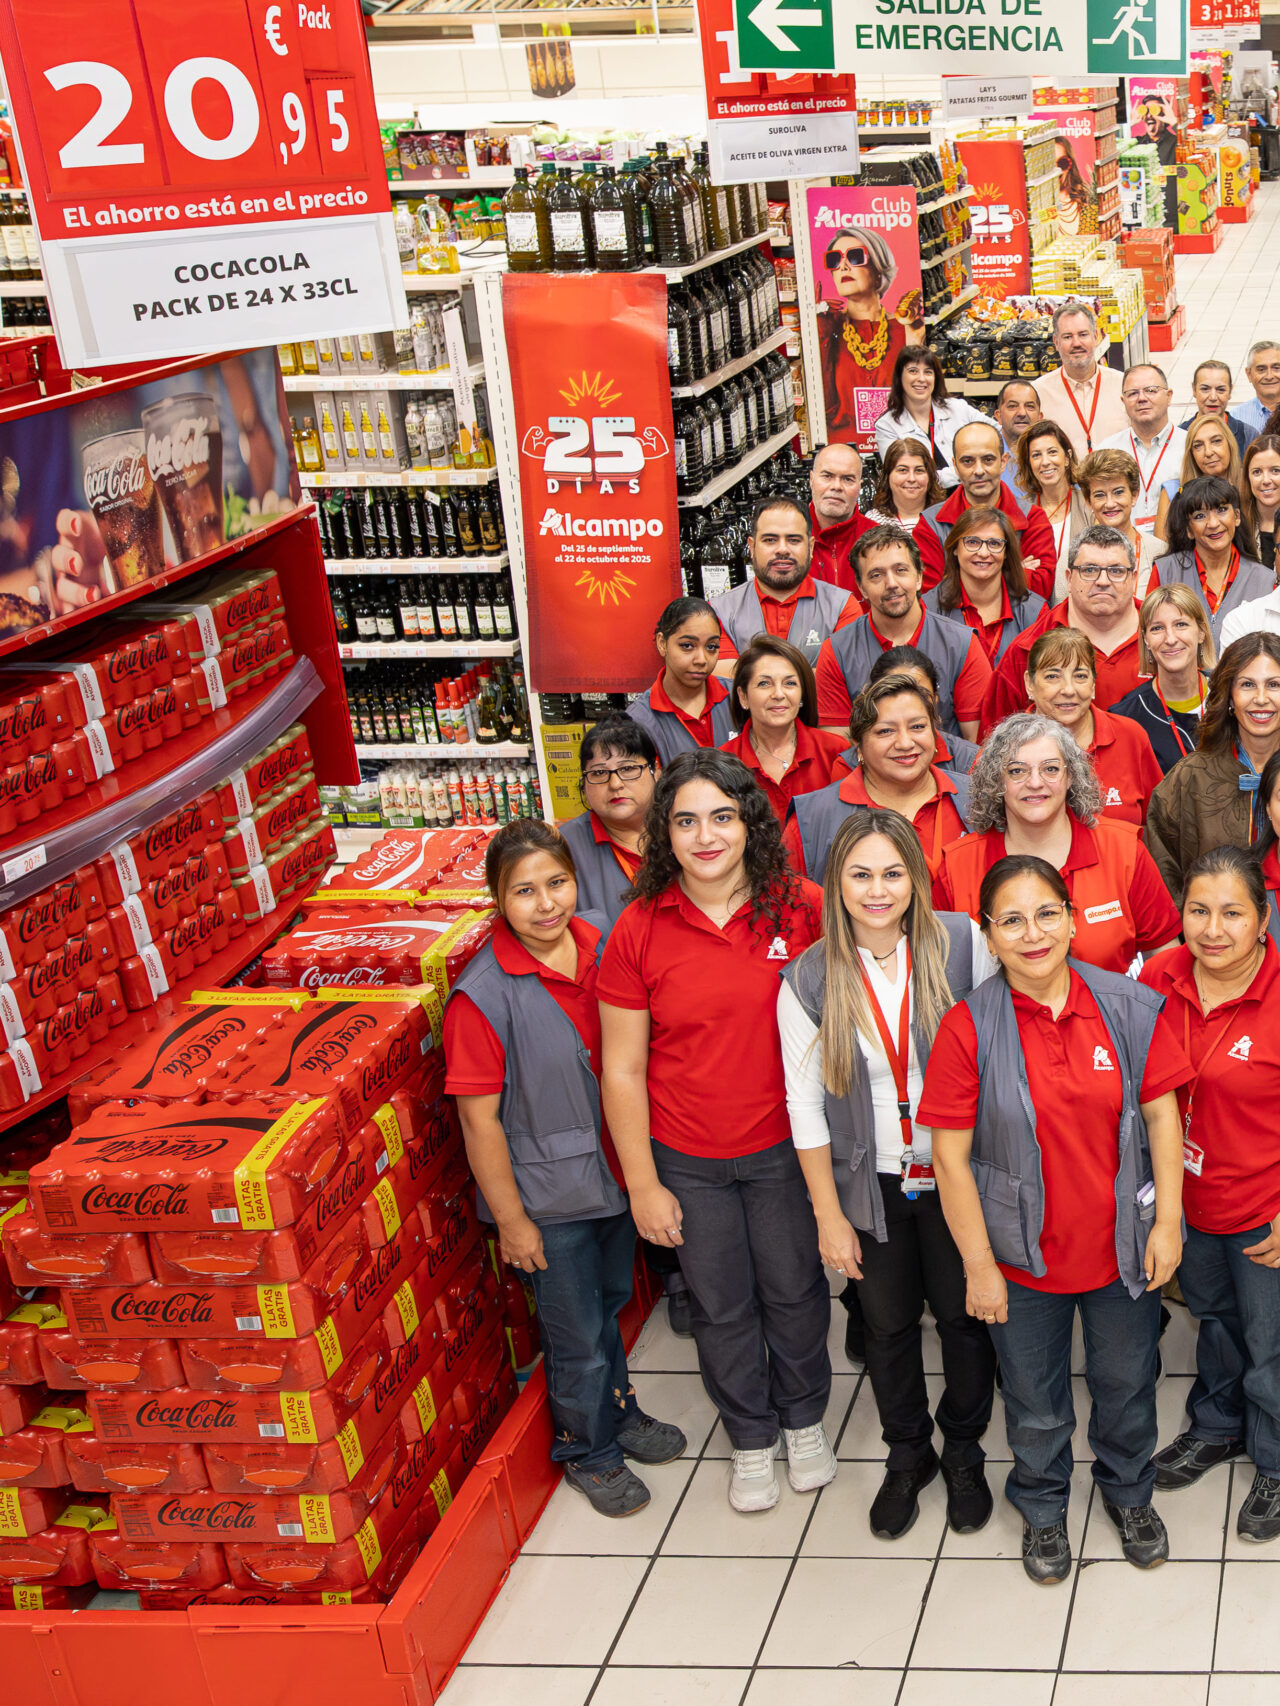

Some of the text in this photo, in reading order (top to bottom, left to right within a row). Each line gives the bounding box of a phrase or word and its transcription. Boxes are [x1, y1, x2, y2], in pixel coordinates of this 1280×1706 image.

[298, 5, 331, 31] Pack
[876, 0, 1043, 16] SALIDA DE
[856, 25, 1063, 52] EMERGENCIA
[717, 97, 847, 114] El ahorro está en el precio
[949, 97, 976, 105] PATATAS
[998, 94, 1028, 102] GOURMET
[768, 125, 807, 135] SUROLIVA
[1066, 117, 1091, 128] Club
[730, 145, 848, 161] ACEITE DE OLIVA VIRGEN EXTRA
[63, 187, 368, 228] El ahorro está en el precio
[814, 206, 912, 231] Alcampo
[871, 197, 911, 213] Club
[968, 205, 1014, 234] 25
[173, 252, 310, 284] COCACOLA
[133, 277, 358, 322] PACK DE 24 X 33CL
[543, 417, 645, 481] 25
[547, 477, 640, 494] DÍAS
[539, 508, 664, 541] Alcampo
[555, 555, 651, 563] al 22 de octubre de 2025
[561, 545, 643, 554] Del 25 de septiembre
[352, 839, 415, 881] Coca-Cola
[162, 1017, 247, 1079] Coca-Cola
[299, 1014, 378, 1076] Coca-Cola
[80, 1184, 190, 1216] Coca-Cola
[241, 1179, 255, 1215] LATAS
[252, 1182, 267, 1220] GRATIS
[111, 1292, 215, 1322] Coca-Cola
[263, 1289, 277, 1322] LATAS
[275, 1291, 289, 1328] GRATIS
[135, 1399, 239, 1428] Coca-Cola
[286, 1397, 299, 1429] LATAS
[297, 1399, 311, 1435] GRATIS
[157, 1499, 258, 1529] Coca-Cola
[305, 1499, 318, 1529] LATAS
[316, 1501, 329, 1535] GRATIS
